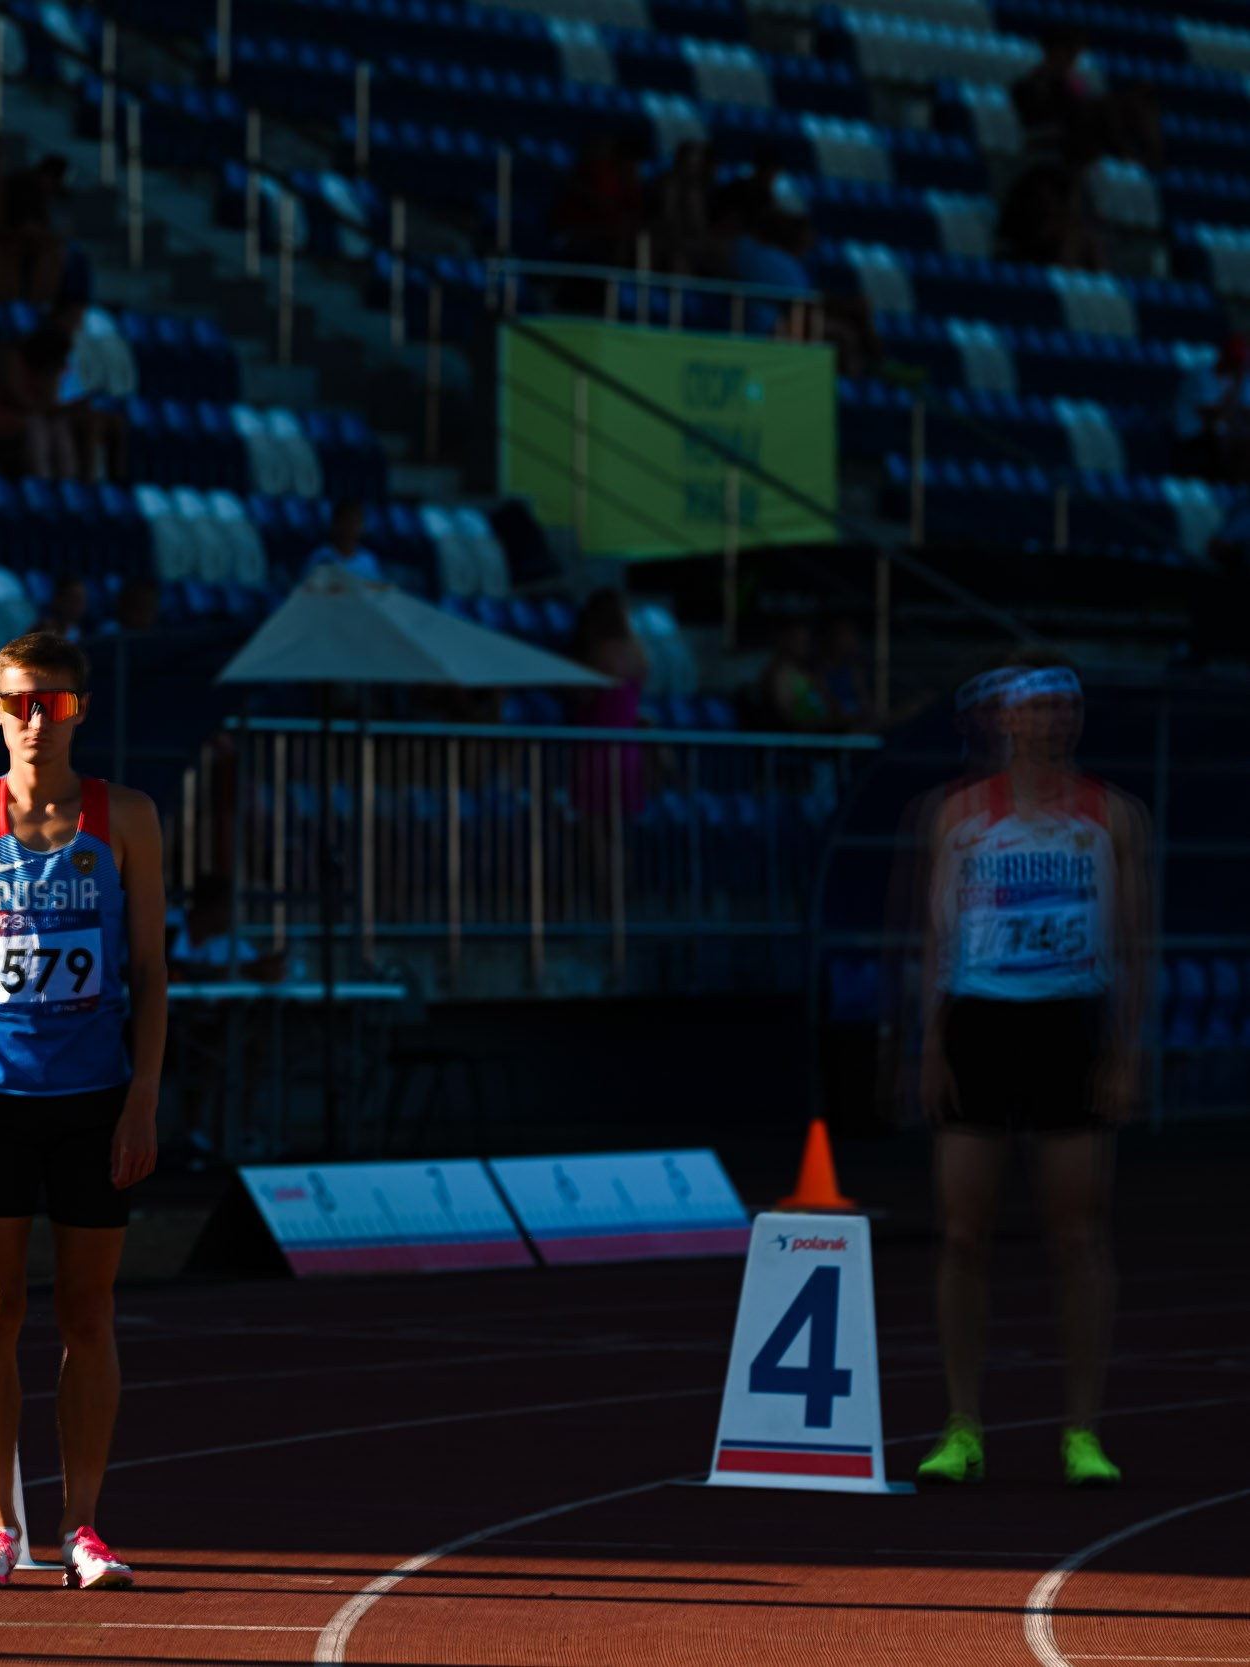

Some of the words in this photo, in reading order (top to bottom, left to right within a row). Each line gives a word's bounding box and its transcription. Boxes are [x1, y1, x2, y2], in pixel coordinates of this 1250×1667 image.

[0, 946, 94, 994] 579
[791, 1235, 848, 1252] polanik
[749, 1266, 852, 1429] 4
